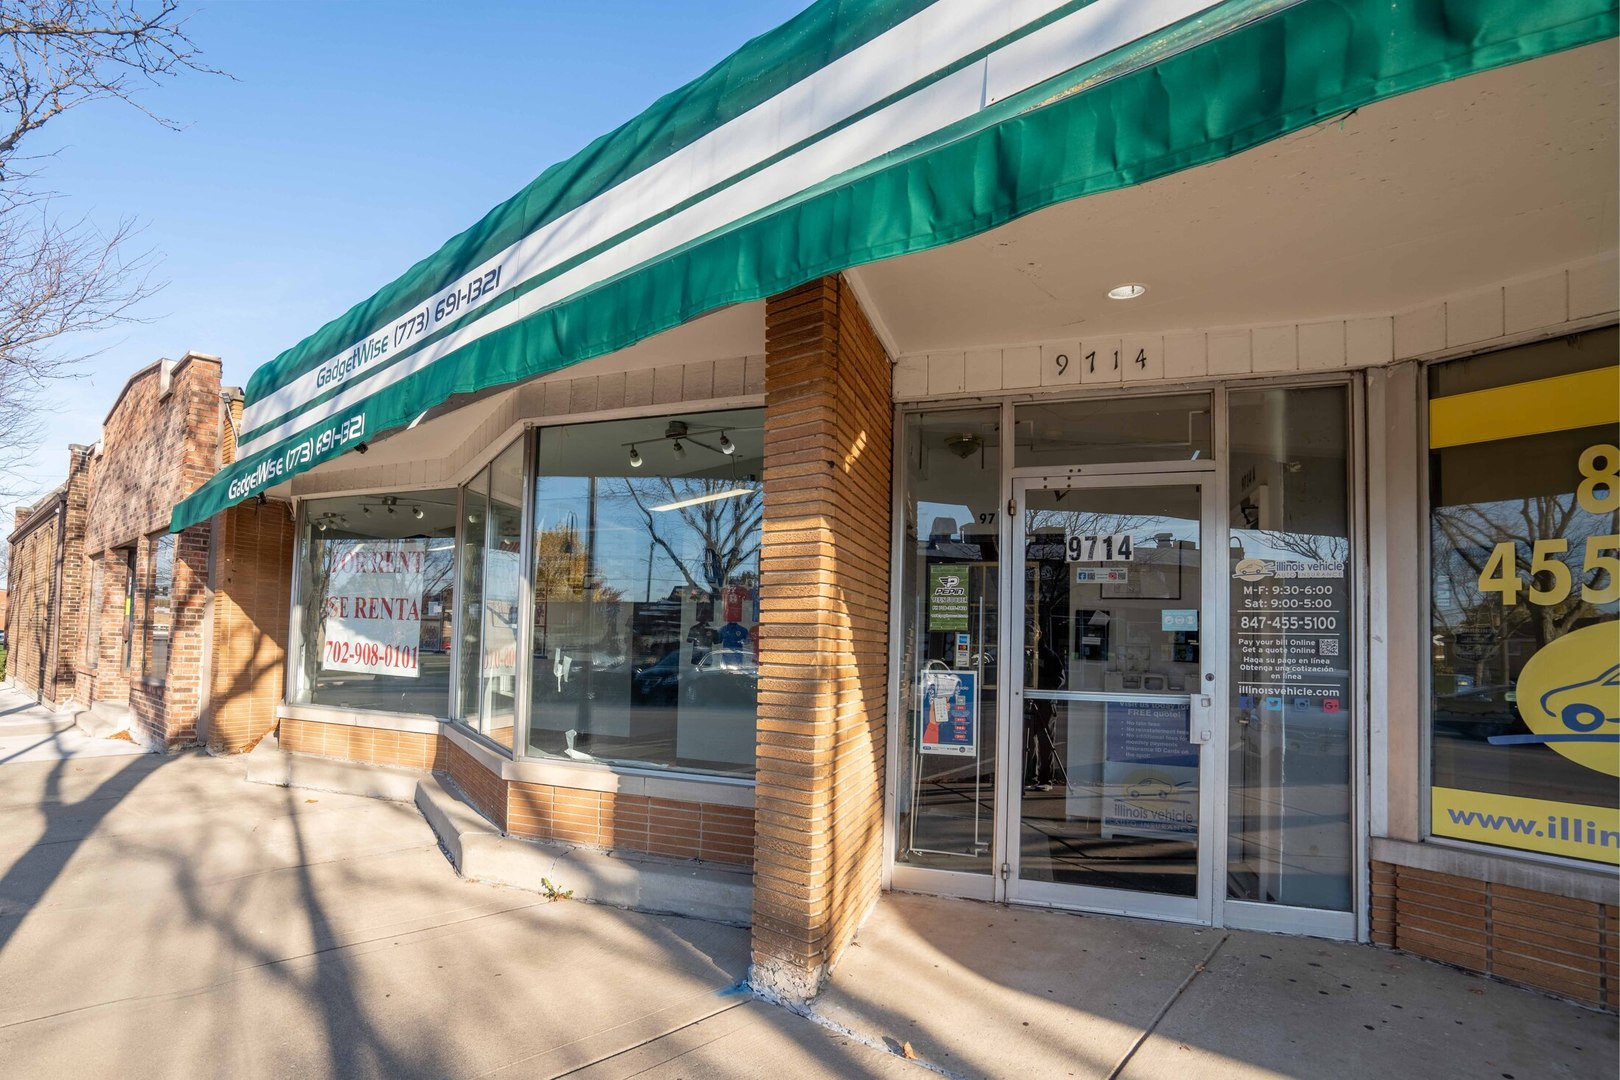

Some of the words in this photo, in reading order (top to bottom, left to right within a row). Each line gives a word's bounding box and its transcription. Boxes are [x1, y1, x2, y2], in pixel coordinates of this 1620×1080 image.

[316, 335, 388, 389] GadgetWise
[394, 307, 429, 348] (773)
[434, 265, 502, 322] 691-1321
[1055, 348, 1147, 376] 9714
[228, 457, 283, 500] GadgetWse
[286, 438, 314, 472] (773)
[316, 412, 366, 456] 691-1321
[1067, 535, 1132, 561] 9714
[1276, 562, 1305, 572] illinois
[1308, 561, 1343, 571] vehicle
[1478, 534, 1620, 606] 455
[1244, 586, 1269, 595] M-F:
[1272, 586, 1333, 595] 9:30-6:00
[354, 596, 420, 620] RENTA
[1244, 599, 1267, 608] Sat:
[1271, 599, 1332, 608] 9:00-5:00
[1240, 616, 1336, 630] 847-455-5100
[326, 640, 418, 668] 702-908-0101
[1243, 657, 1263, 665] Haga
[1239, 686, 1340, 696] illinoisvehicle.com
[1114, 804, 1148, 819] illinois
[1152, 808, 1194, 823] vehicle
